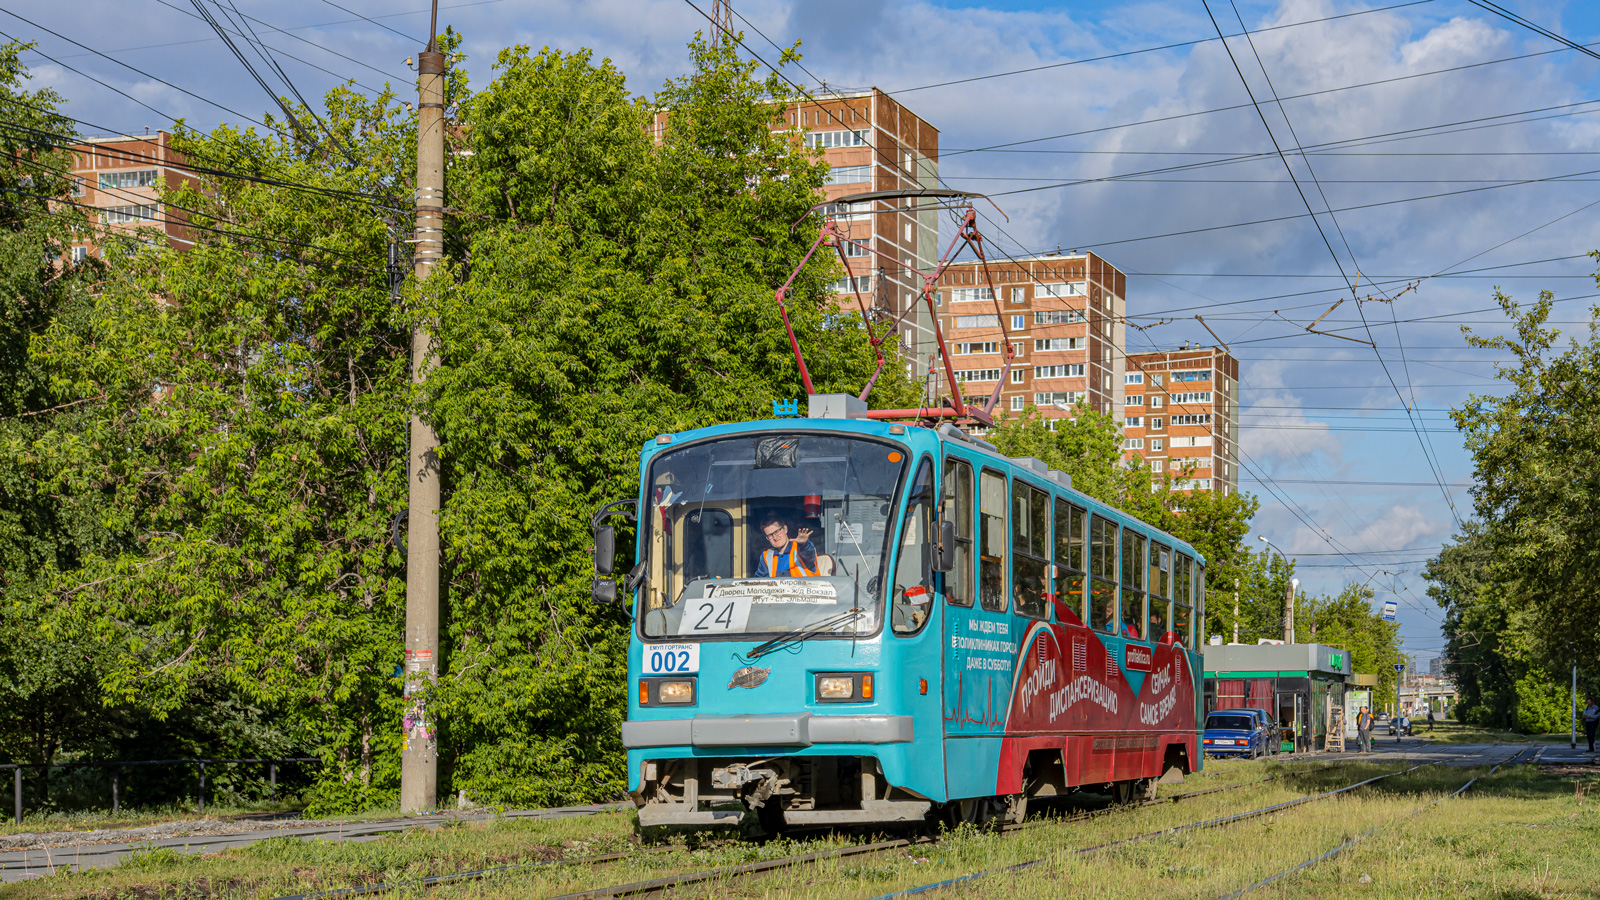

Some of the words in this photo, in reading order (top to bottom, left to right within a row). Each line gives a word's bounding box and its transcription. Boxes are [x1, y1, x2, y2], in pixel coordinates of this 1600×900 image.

[705, 585, 717, 598] 7
[720, 589, 745, 597] Дворец
[746, 587, 785, 596] Молодежи
[791, 587, 805, 595] ж/д
[806, 587, 833, 596] Вокзал
[694, 602, 735, 630] 24
[968, 619, 979, 631] МЫ
[979, 620, 996, 634] ЖДЕМ
[996, 622, 1009, 634] ТЕБЯ
[957, 636, 1000, 652] ПОЛИКЛИНИКАХ
[1000, 641, 1018, 654] ГОРОДА
[651, 651, 690, 672] 002
[966, 656, 983, 671] ДАЖЕ
[982, 658, 987, 670] В
[987, 658, 1012, 672] СУББОТУ!
[1021, 658, 1056, 714] ПРОЙДИ
[1151, 663, 1171, 695] СЕЙЧАС
[1049, 675, 1118, 724] ДИСПАНСЕРИЗАЦИЮ
[1140, 701, 1159, 726] САМОЕ
